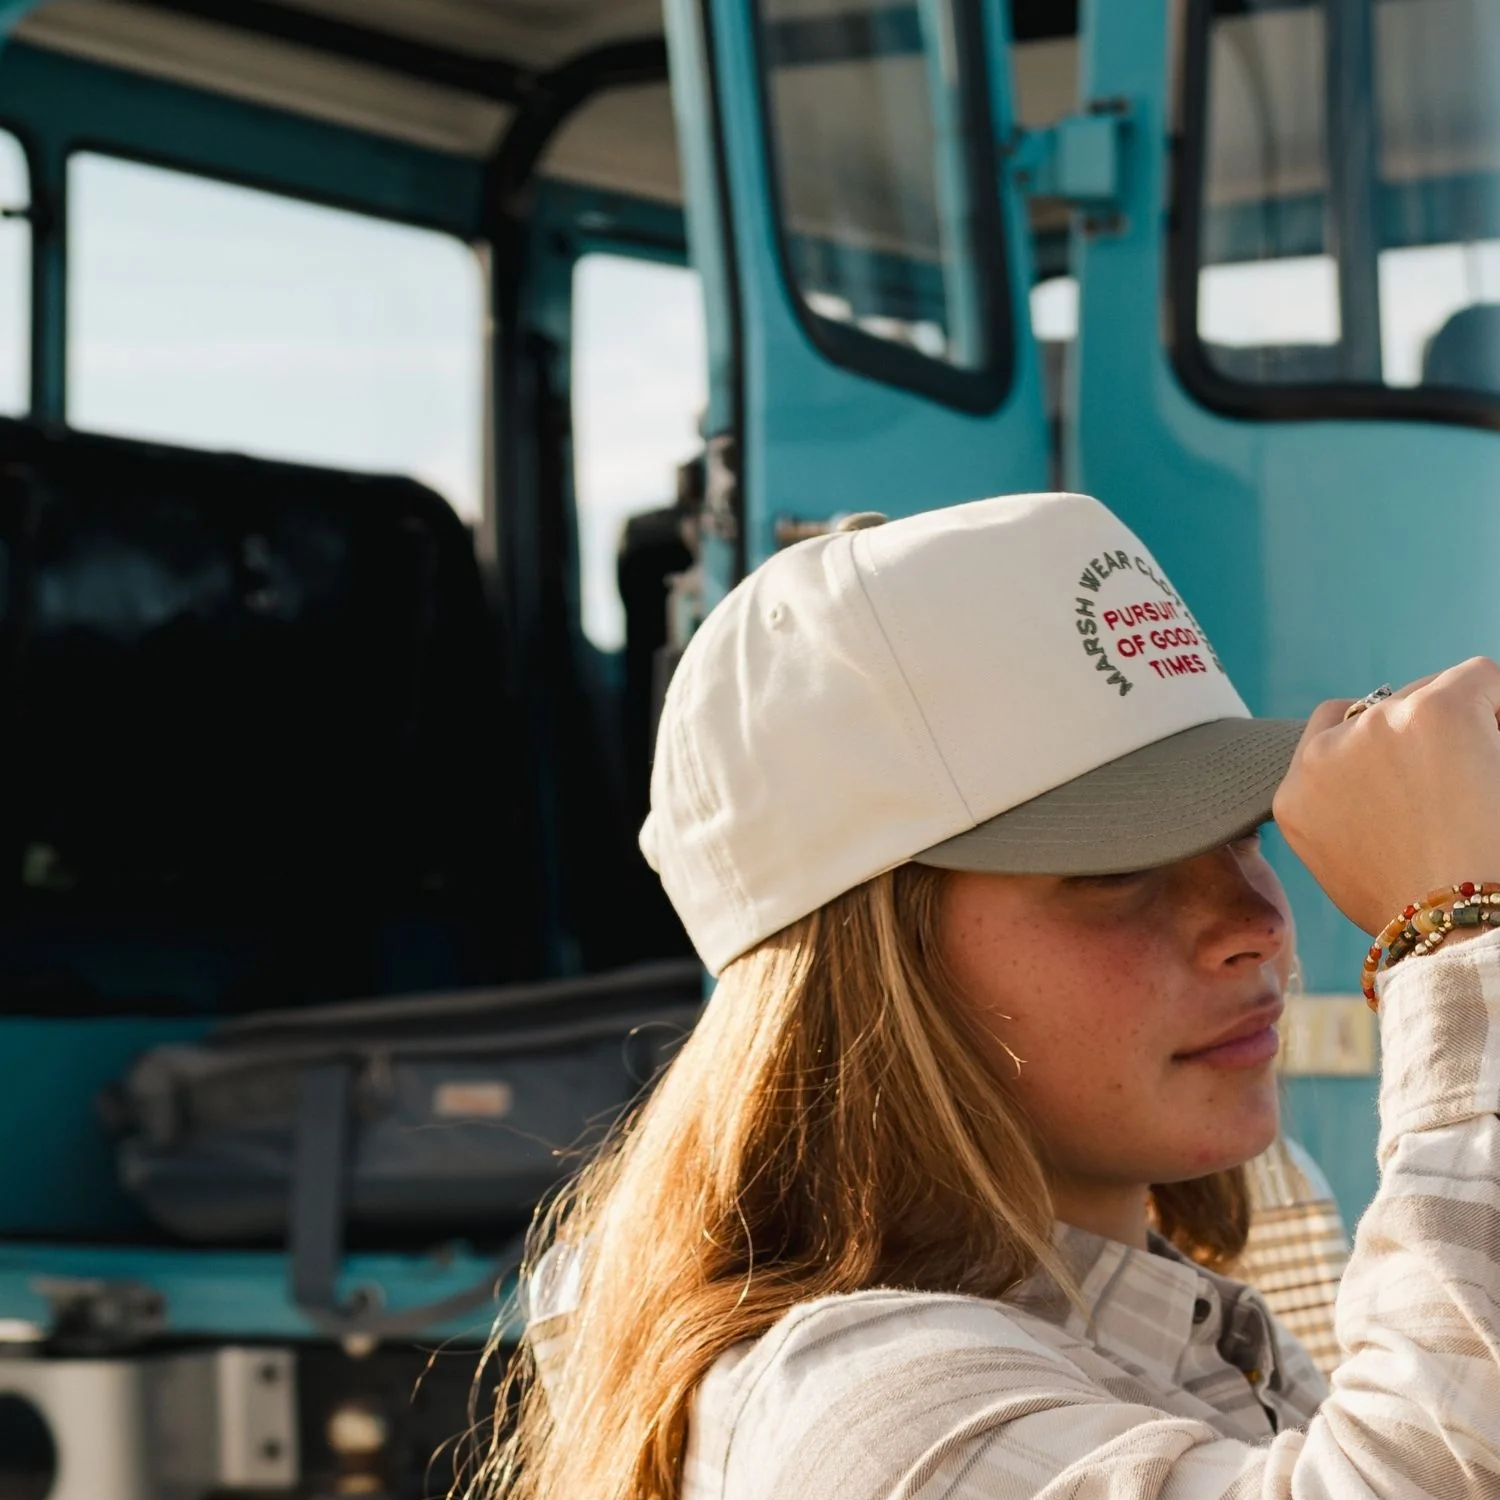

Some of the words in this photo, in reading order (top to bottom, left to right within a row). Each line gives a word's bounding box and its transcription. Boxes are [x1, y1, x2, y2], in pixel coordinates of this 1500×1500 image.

[1078, 550, 1133, 592] WEAR
[1103, 601, 1178, 630] PURSUIT
[1075, 597, 1133, 696] MARSH
[1117, 634, 1146, 657] OF
[1150, 627, 1199, 650] GOOD
[1149, 653, 1207, 679] TIMES
